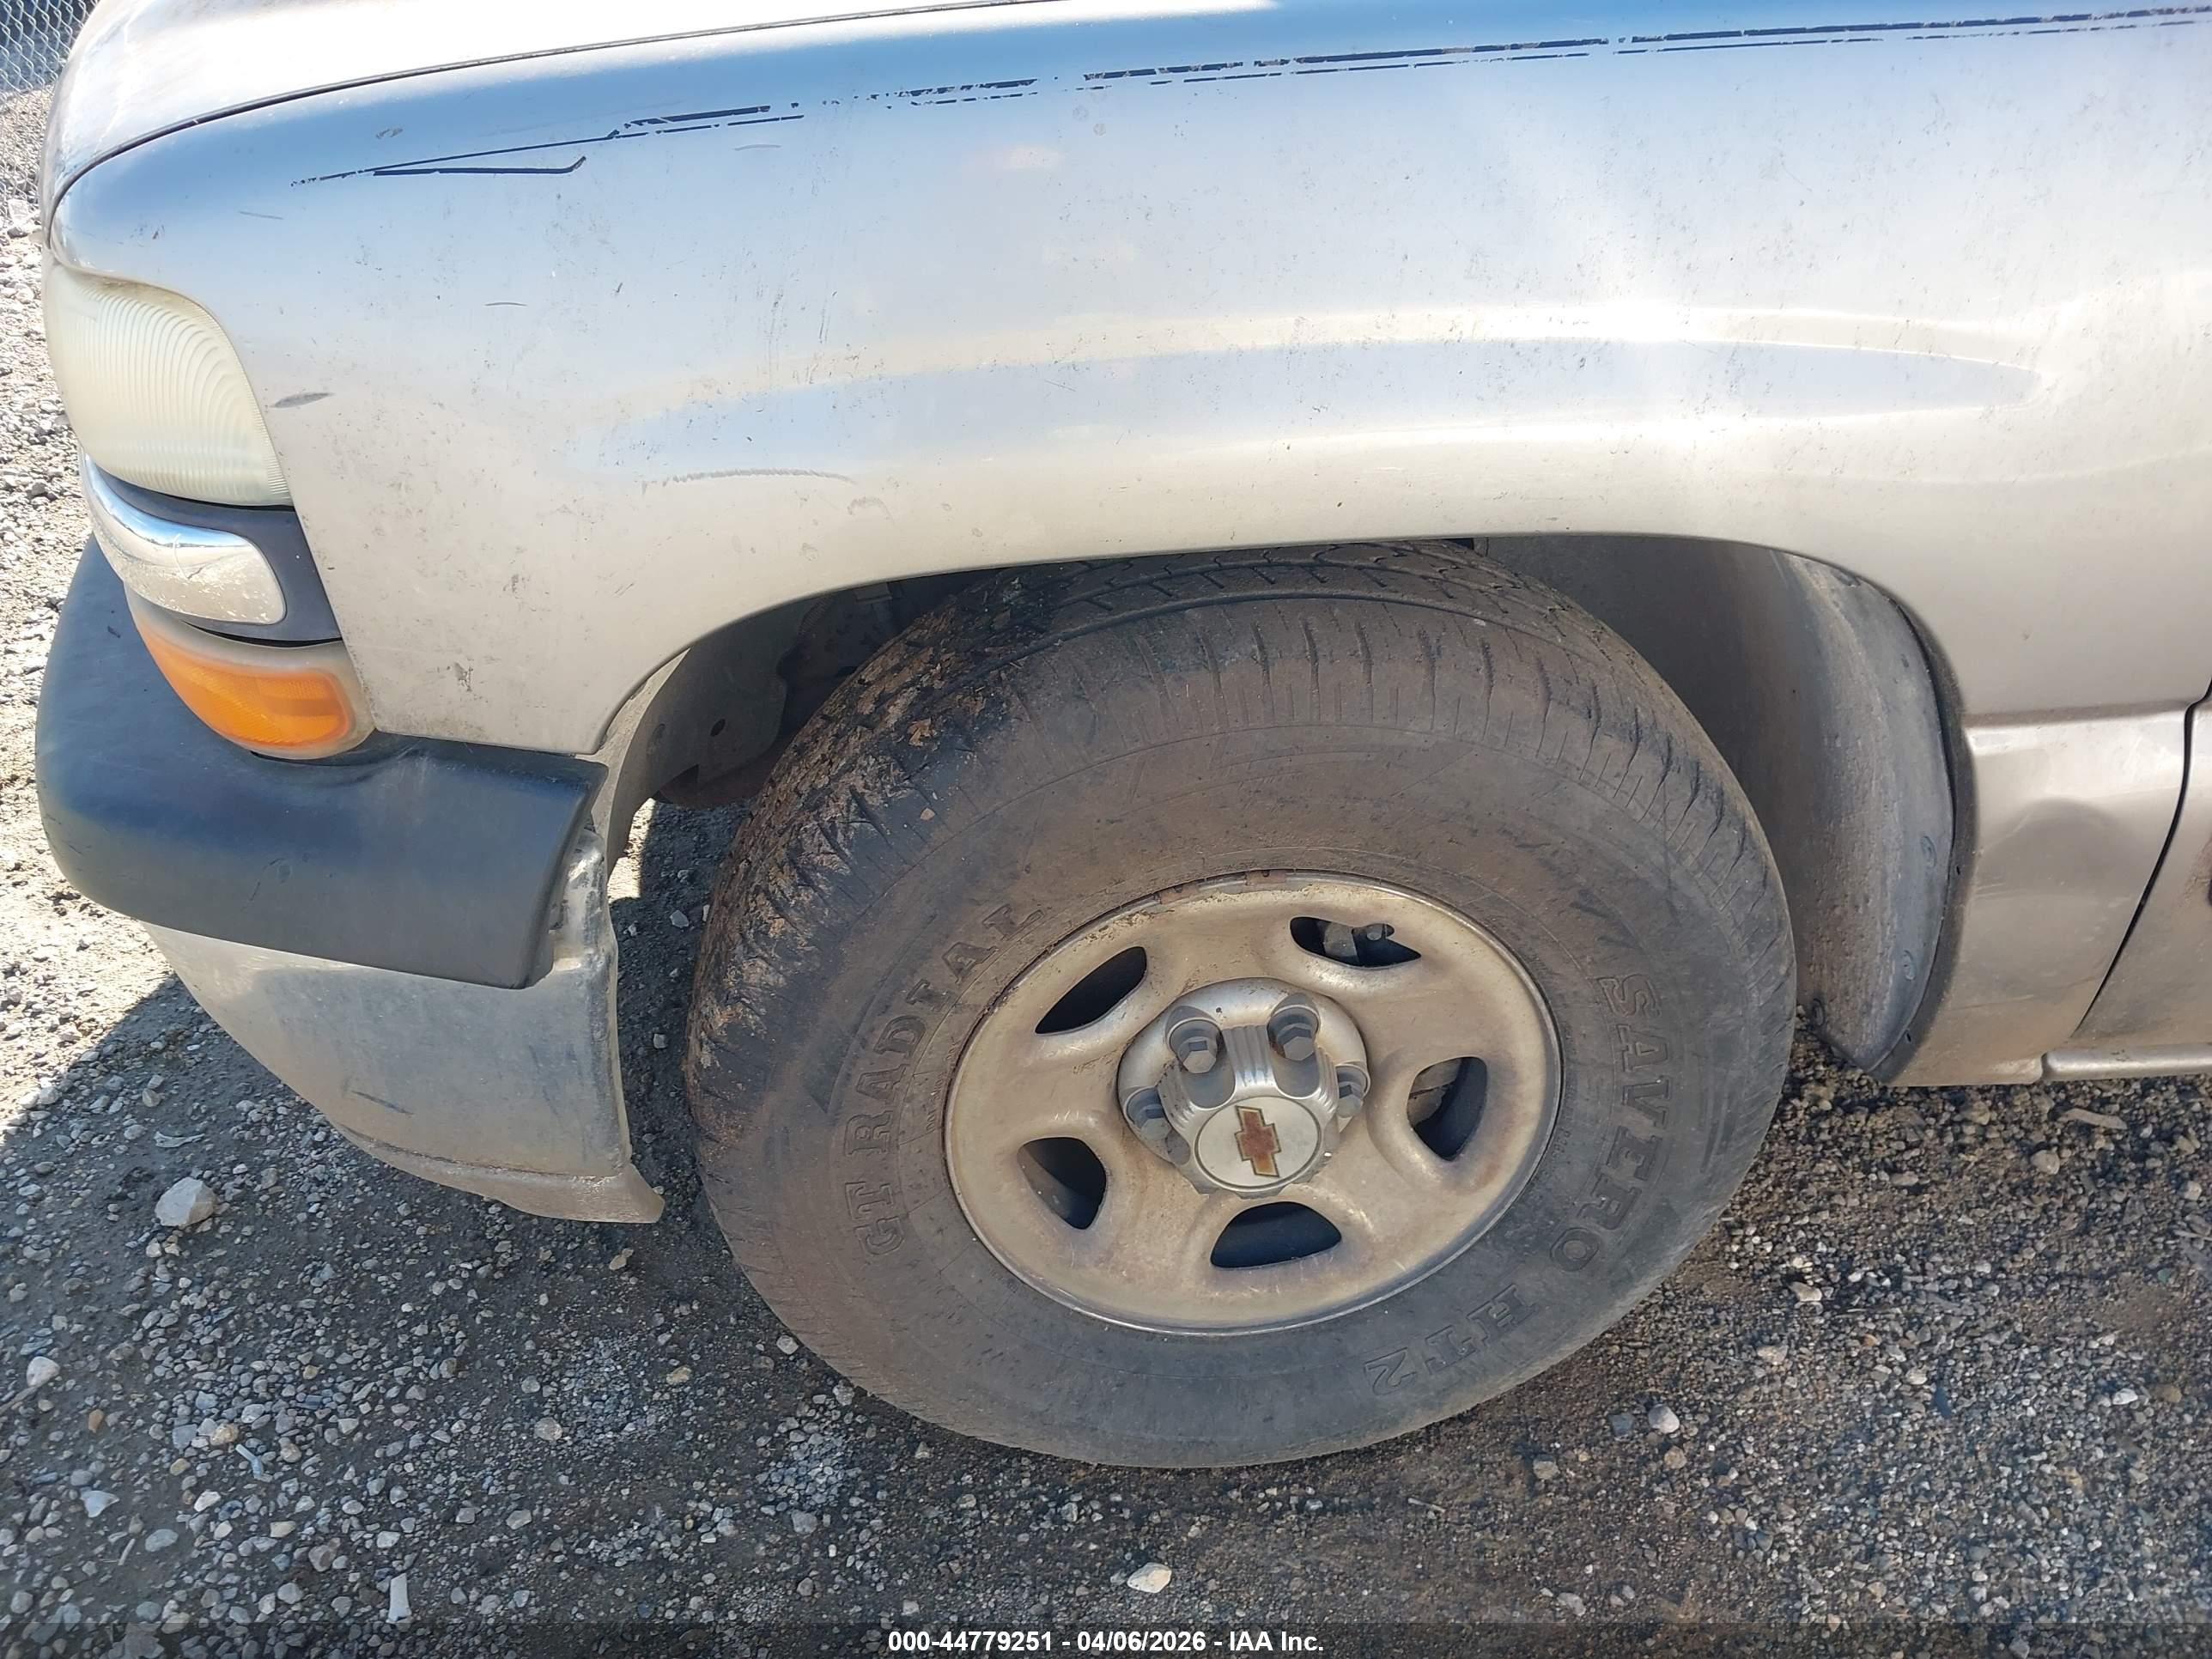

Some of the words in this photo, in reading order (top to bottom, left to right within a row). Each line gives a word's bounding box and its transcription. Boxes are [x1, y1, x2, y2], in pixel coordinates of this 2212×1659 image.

[844, 904, 1044, 1157] RADIAL
[1550, 974, 1671, 1273] SAVERO
[845, 1182, 905, 1255] GT
[1364, 1285, 1536, 1395] HT2
